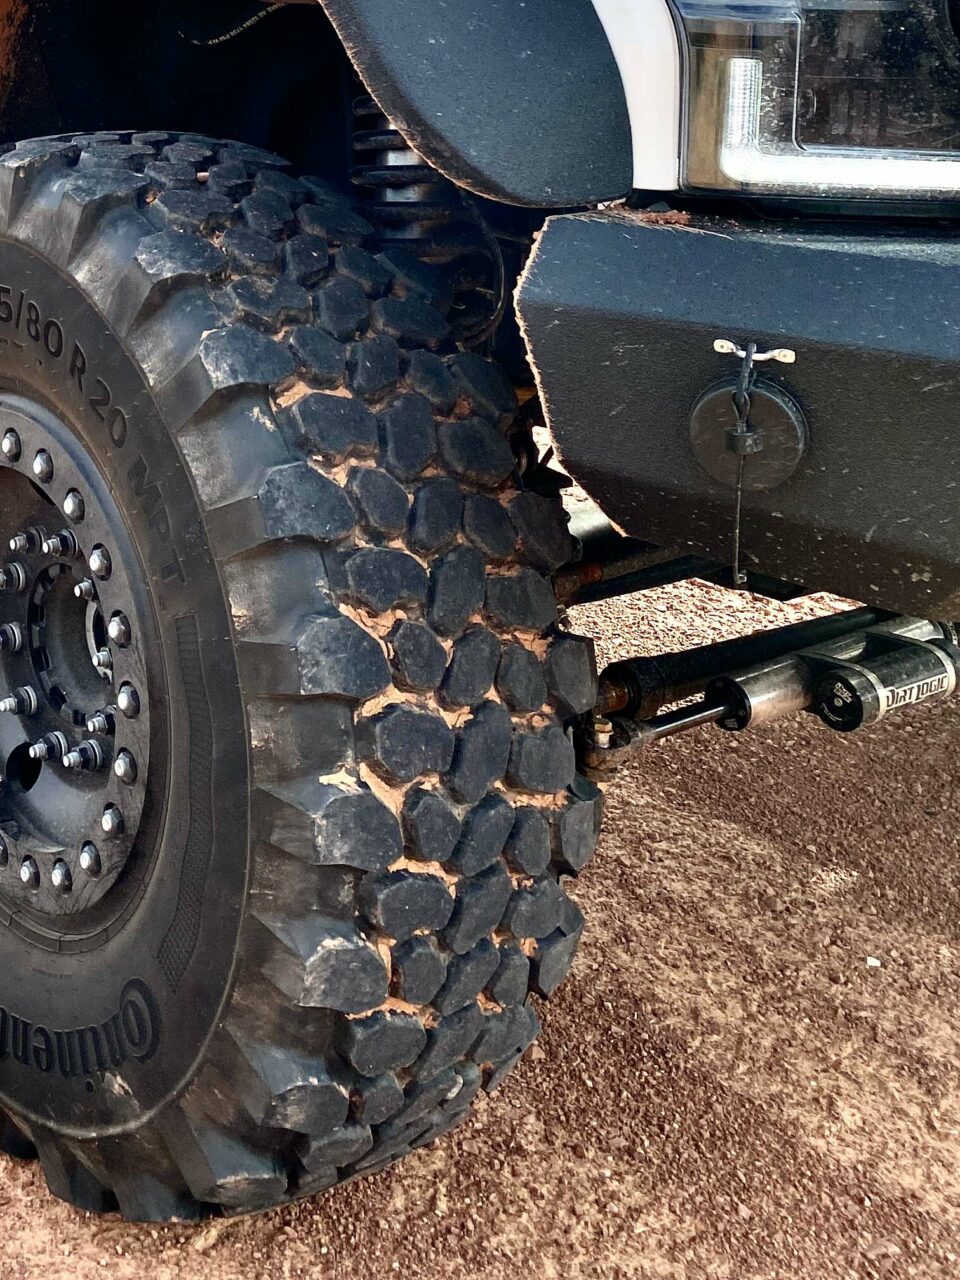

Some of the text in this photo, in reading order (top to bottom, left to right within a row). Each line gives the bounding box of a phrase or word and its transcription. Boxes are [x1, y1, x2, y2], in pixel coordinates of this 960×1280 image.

[69, 339, 87, 393] R
[90, 376, 128, 449] 20
[886, 676, 948, 708] DIRT LOGIC
